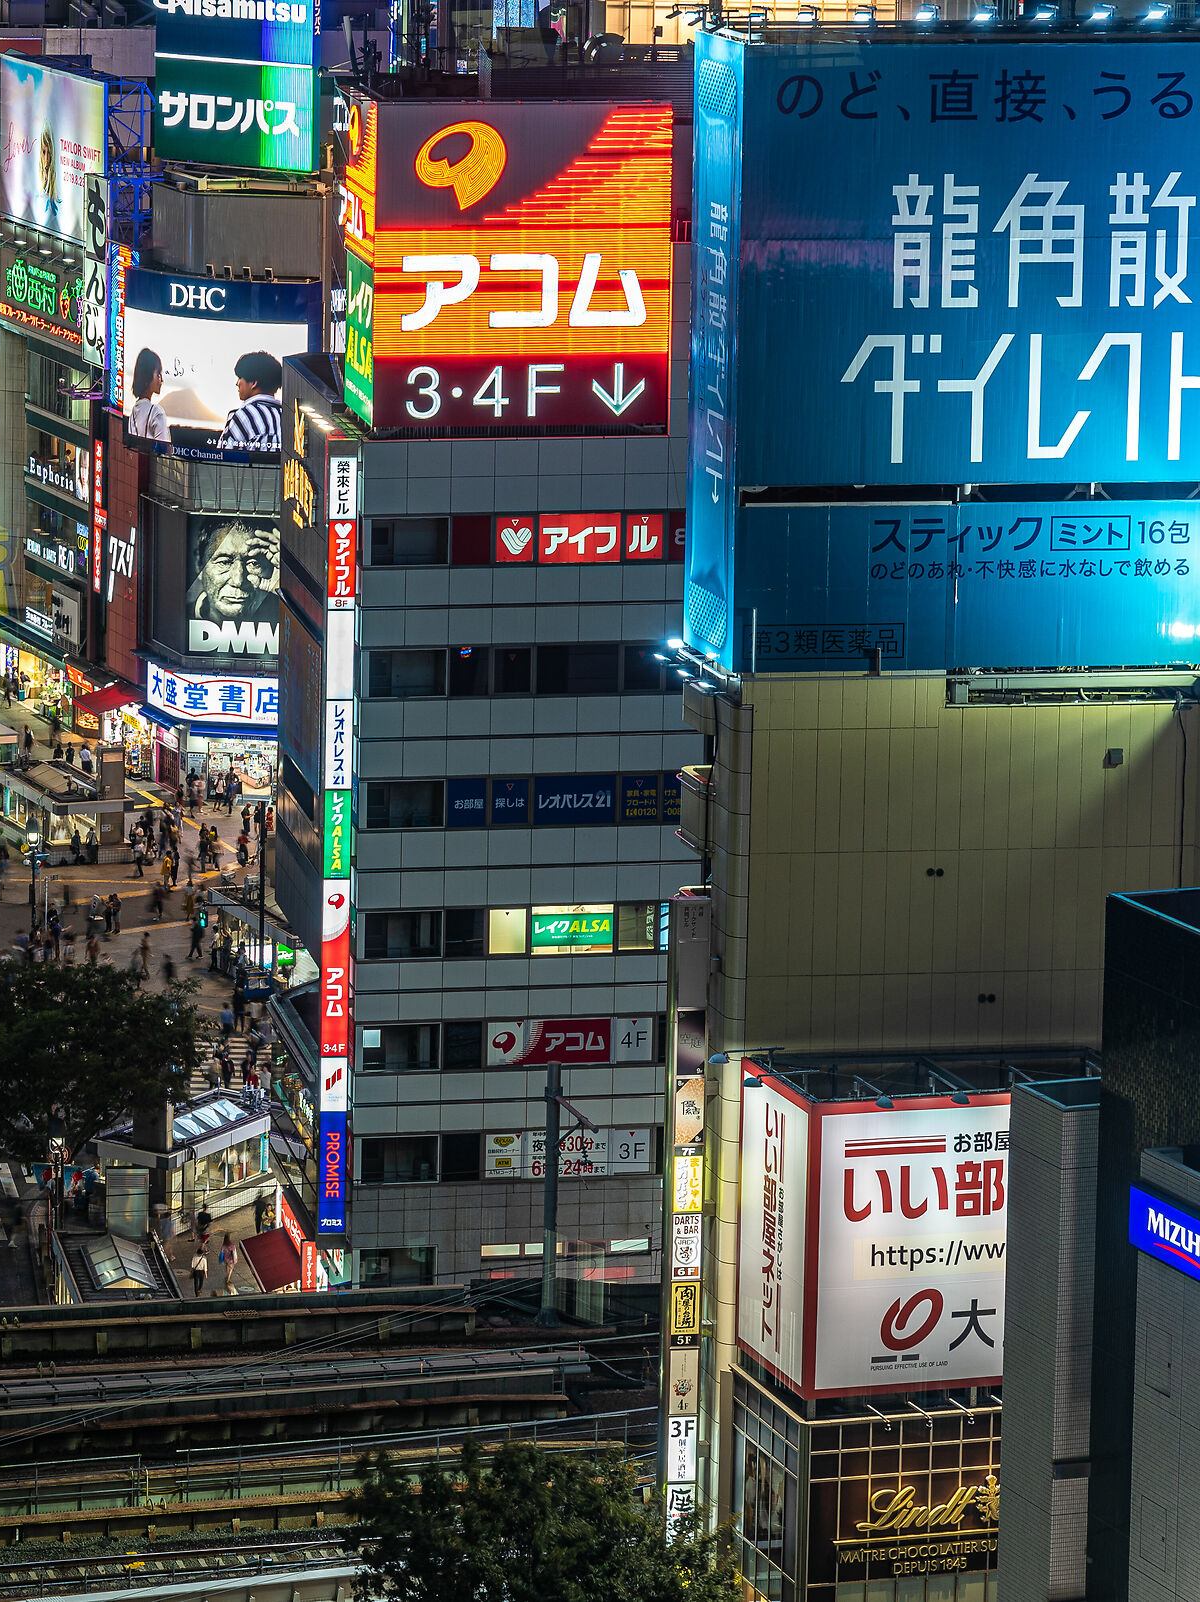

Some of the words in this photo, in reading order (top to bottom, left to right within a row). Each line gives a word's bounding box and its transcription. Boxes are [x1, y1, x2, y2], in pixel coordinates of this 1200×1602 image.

[776, 68, 1194, 124] のど、直接、うる
[159, 91, 300, 138] サロンパス
[3, 121, 37, 173] Lover
[60, 138, 82, 156] TAYLOR
[83, 146, 101, 163] SWIFT
[60, 155, 70, 168] NEW
[70, 157, 86, 172] ALBUM
[338, 184, 367, 240] アコム
[891, 171, 1198, 310] 龍角散
[28, 278, 57, 316] 西村
[169, 283, 226, 311] DHC
[348, 270, 373, 329] レイク
[401, 252, 647, 332] アコム
[346, 326, 372, 384] ALSA
[706, 201, 729, 500] 龍角散ダイレクト
[839, 331, 1200, 464] ダイレクト
[171, 446, 190, 458] DHC
[190, 448, 224, 461] Channel
[29, 456, 75, 492] Euphoria
[542, 524, 658, 556] アイフル
[871, 516, 1043, 553] スティック
[1057, 522, 1124, 546] ミント
[1137, 520, 1191, 545] 16包
[335, 538, 350, 597] アイフル
[870, 559, 1191, 580] のどのあれ・不快感に水なしで飲める
[334, 599, 349, 608] 8F
[189, 619, 279, 655] DMM
[750, 628, 899, 655] 第3類医薬品
[152, 670, 279, 714] 大盛堂書店
[333, 704, 345, 785] レオパレス21
[454, 799, 484, 809] お部屋
[495, 797, 525, 808] 探しは
[538, 790, 612, 809] レオパレス21
[638, 808, 657, 816] 0120
[331, 791, 344, 870] レイクALSA
[534, 919, 610, 934] レイクALSA
[326, 968, 344, 1017] アコム
[545, 1031, 606, 1051] アコム
[620, 1030, 648, 1049] 4F
[326, 1132, 340, 1198] PROMISE
[618, 1142, 646, 1160] 3F
[681, 1148, 696, 1156] 7F
[689, 1157, 699, 1209] まーじゃん
[843, 1159, 1004, 1222] いい部
[320, 1218, 343, 1227] プロミス
[674, 1215, 700, 1226] DARTS
[684, 1226, 699, 1235] BAR
[760, 1102, 780, 1343] いい部屋ネット
[677, 1267, 696, 1276] 6F
[870, 1240, 1005, 1271] https://ww
[676, 1335, 692, 1345] 5F
[949, 1298, 997, 1352] 大
[677, 1399, 689, 1411] 4F
[670, 1420, 695, 1438] 3F
[855, 1485, 978, 1532] Lindt
[839, 1547, 886, 1565] MAÎTRE
[888, 1541, 978, 1560] CHOCOLATIER
[893, 1561, 939, 1575] DEPUIS
[939, 1556, 968, 1570] 1845
